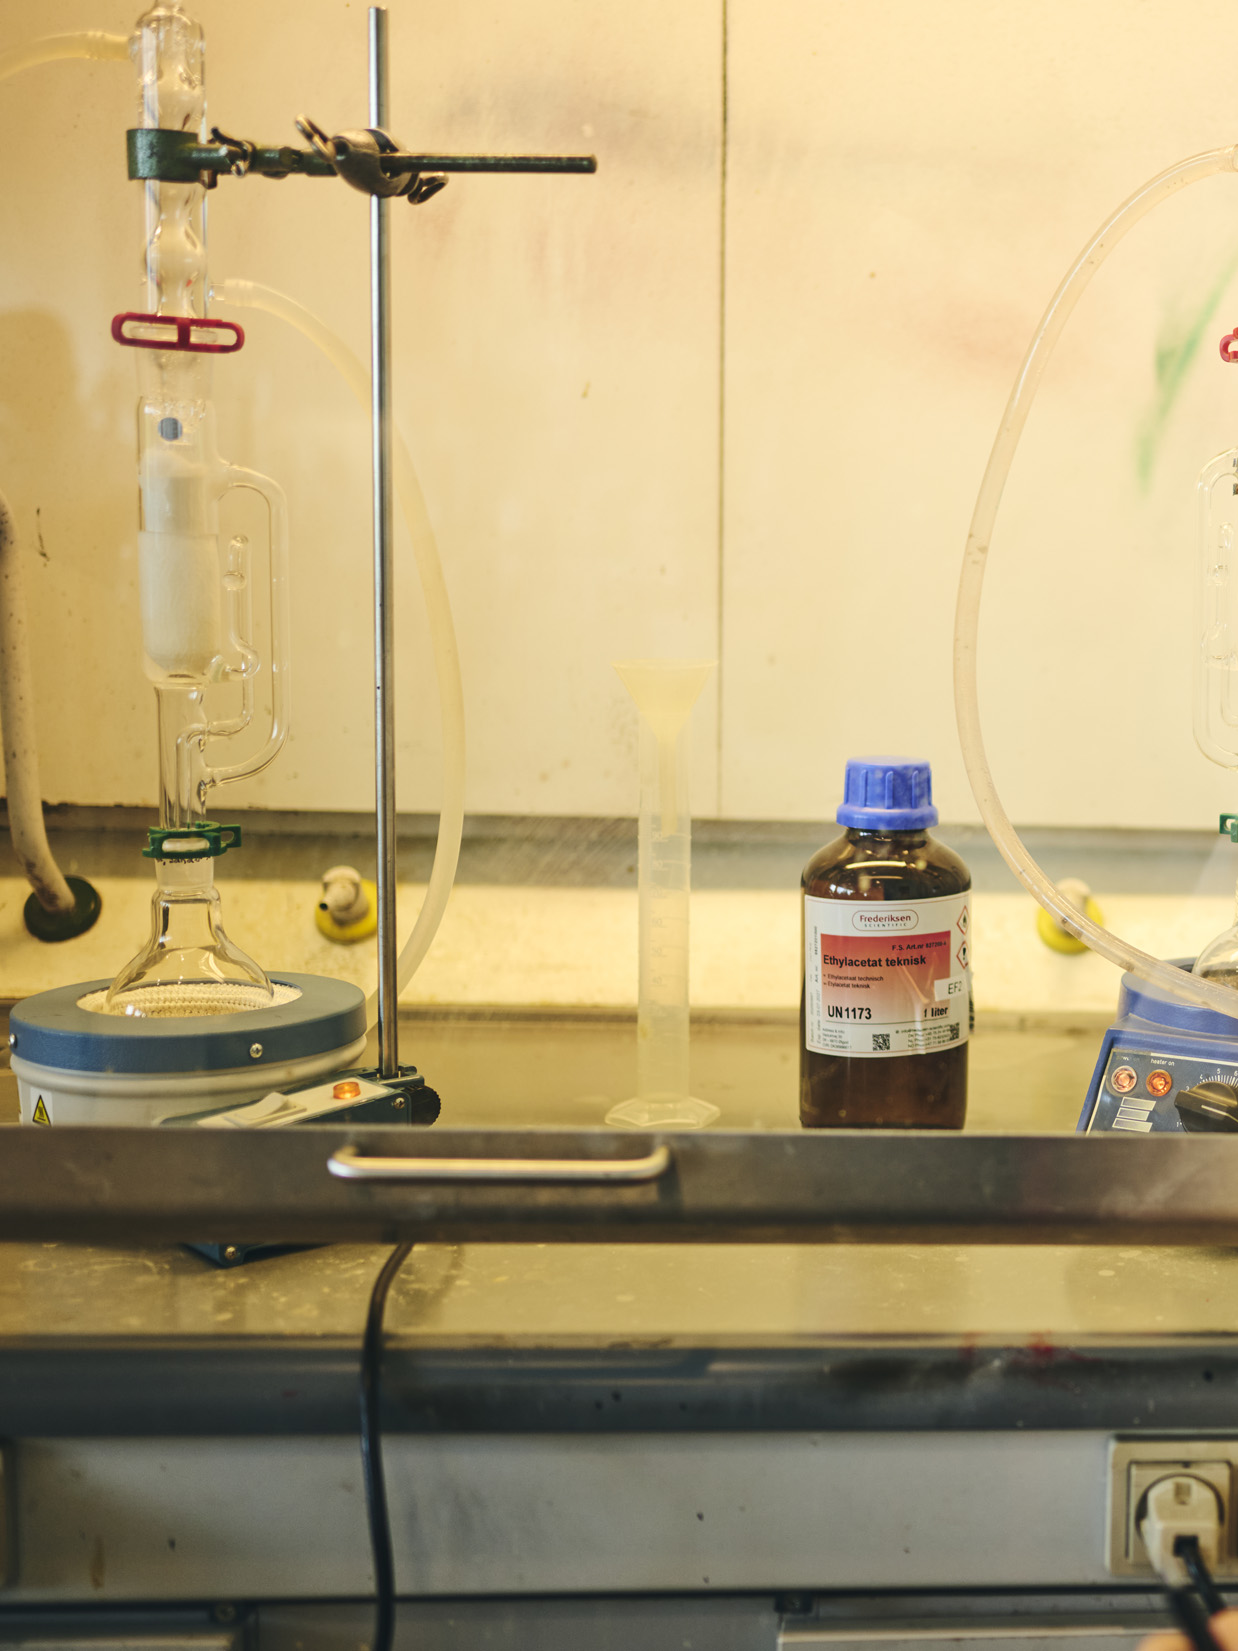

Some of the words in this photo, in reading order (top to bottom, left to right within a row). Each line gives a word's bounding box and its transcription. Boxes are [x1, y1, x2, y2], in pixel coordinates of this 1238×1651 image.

[860, 914, 911, 923] Frederiksen
[823, 954, 882, 968] Ethylacetat
[885, 954, 927, 966] teknisk
[857, 974, 884, 982] technisch
[923, 1007, 928, 1018] 1
[931, 1006, 949, 1018] liter
[1216, 1067, 1221, 1075] 5
